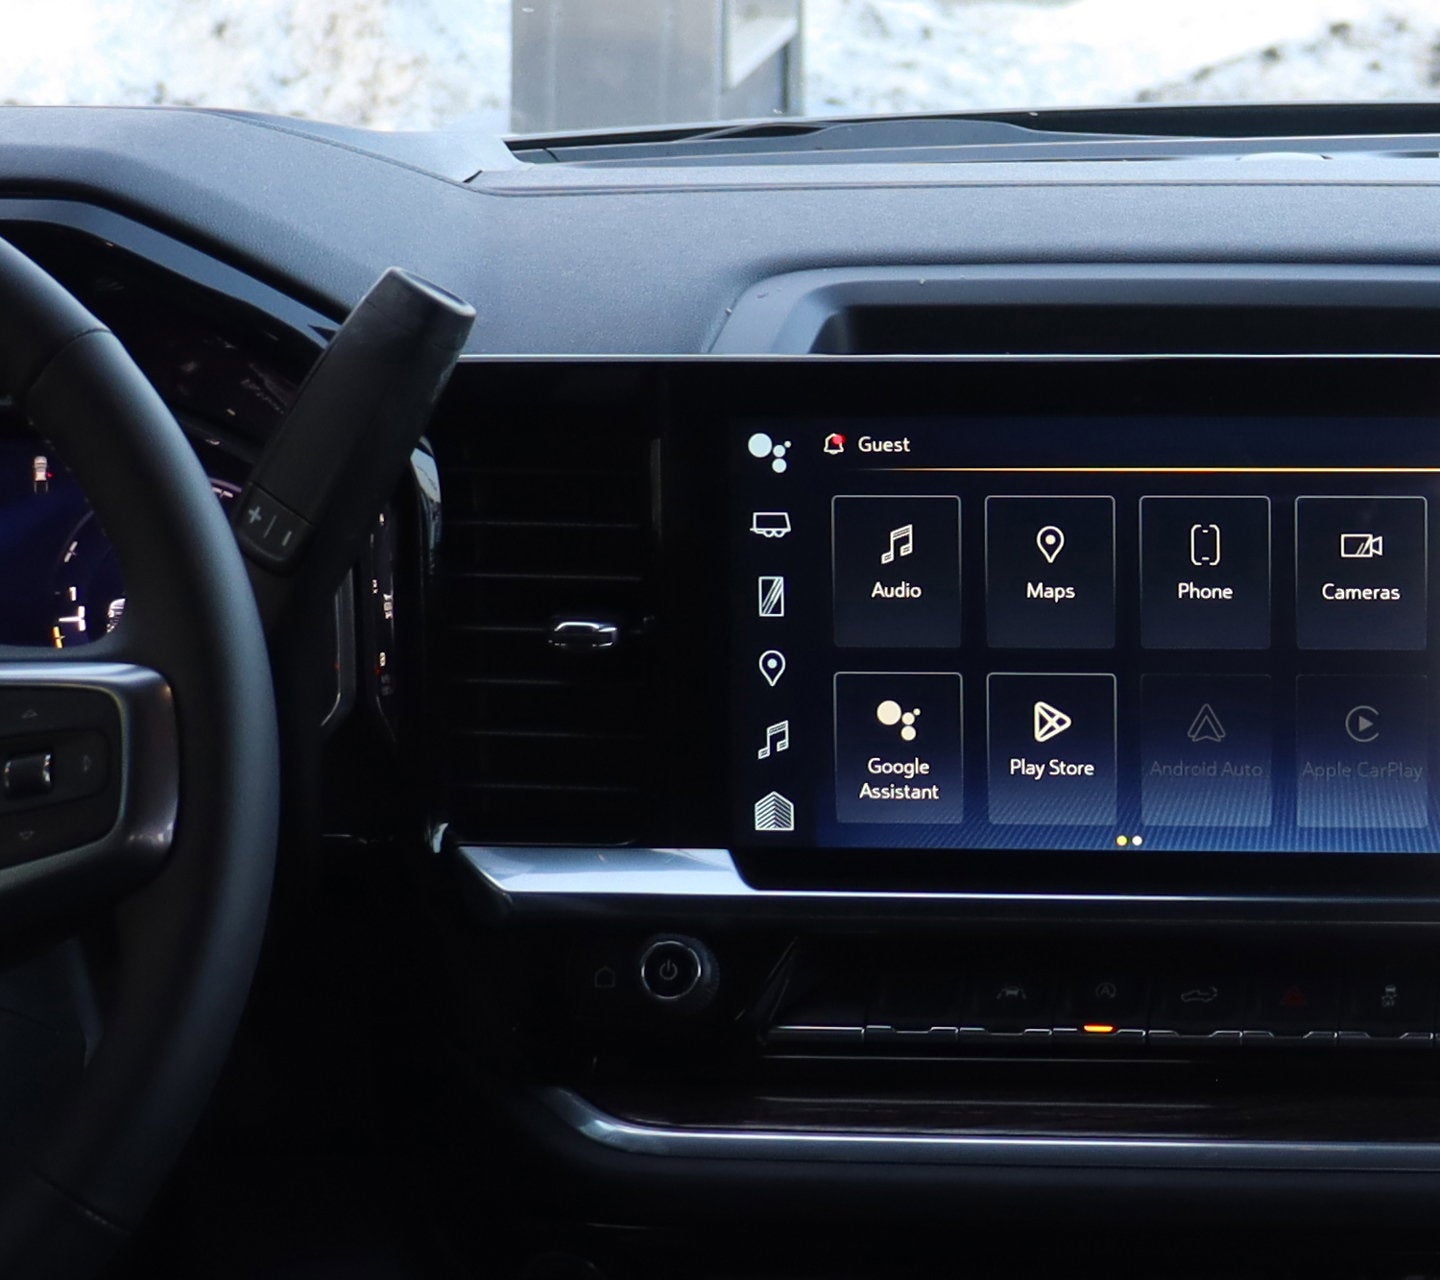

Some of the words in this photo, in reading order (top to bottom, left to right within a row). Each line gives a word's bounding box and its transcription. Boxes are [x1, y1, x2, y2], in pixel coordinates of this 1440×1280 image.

[858, 437, 910, 454] Guest
[871, 582, 922, 599] Audio
[1026, 583, 1075, 604] Maps
[1177, 583, 1233, 600] Phone
[1321, 584, 1401, 601] Cameras
[867, 758, 930, 780] Google
[1009, 758, 1044, 781] Play
[1049, 759, 1095, 777] Store
[1150, 760, 1214, 778] Android
[1220, 761, 1262, 778] Auto
[1302, 762, 1353, 783] Apple
[1357, 761, 1423, 783] CarPlay
[859, 783, 939, 800] Assistant
